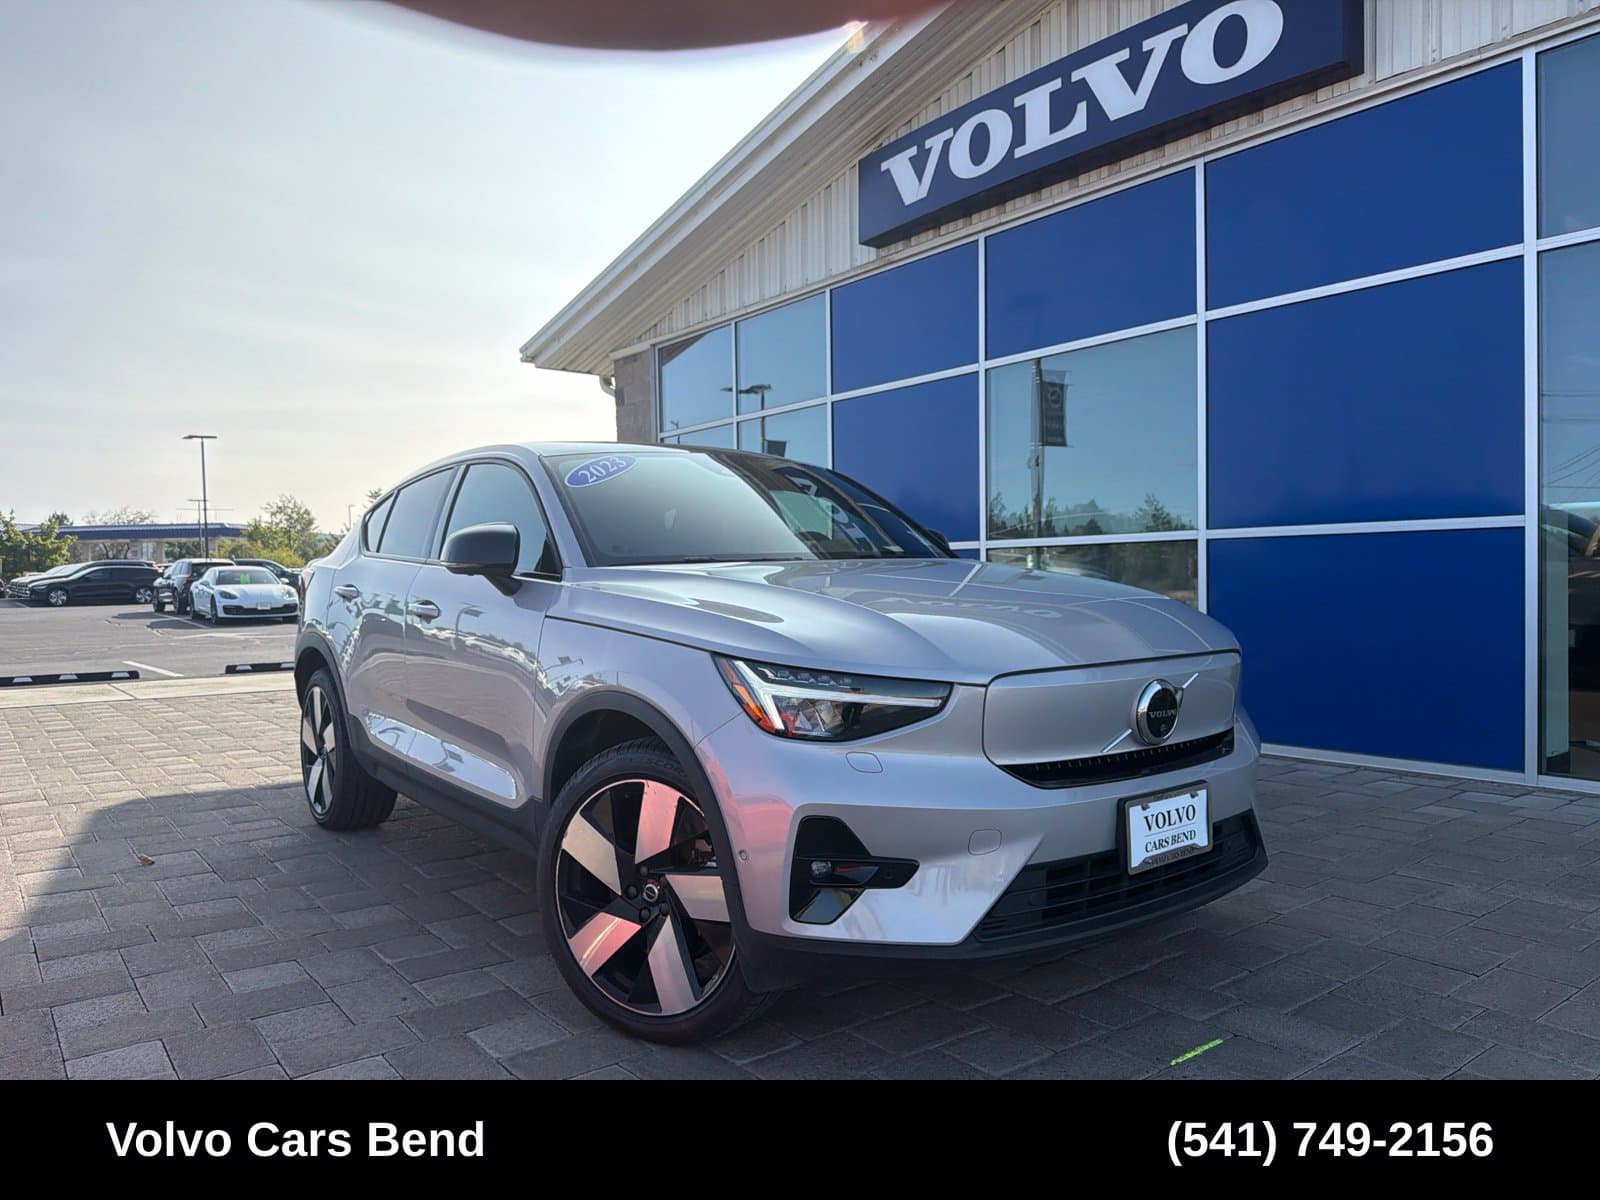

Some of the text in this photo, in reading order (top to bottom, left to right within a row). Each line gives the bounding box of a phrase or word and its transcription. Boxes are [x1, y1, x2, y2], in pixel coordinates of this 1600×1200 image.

[881, 0, 1285, 207] VOLVO
[578, 455, 627, 483] 2023
[1144, 804, 1196, 832] VOLVO
[1144, 829, 1197, 853] CARS BEND
